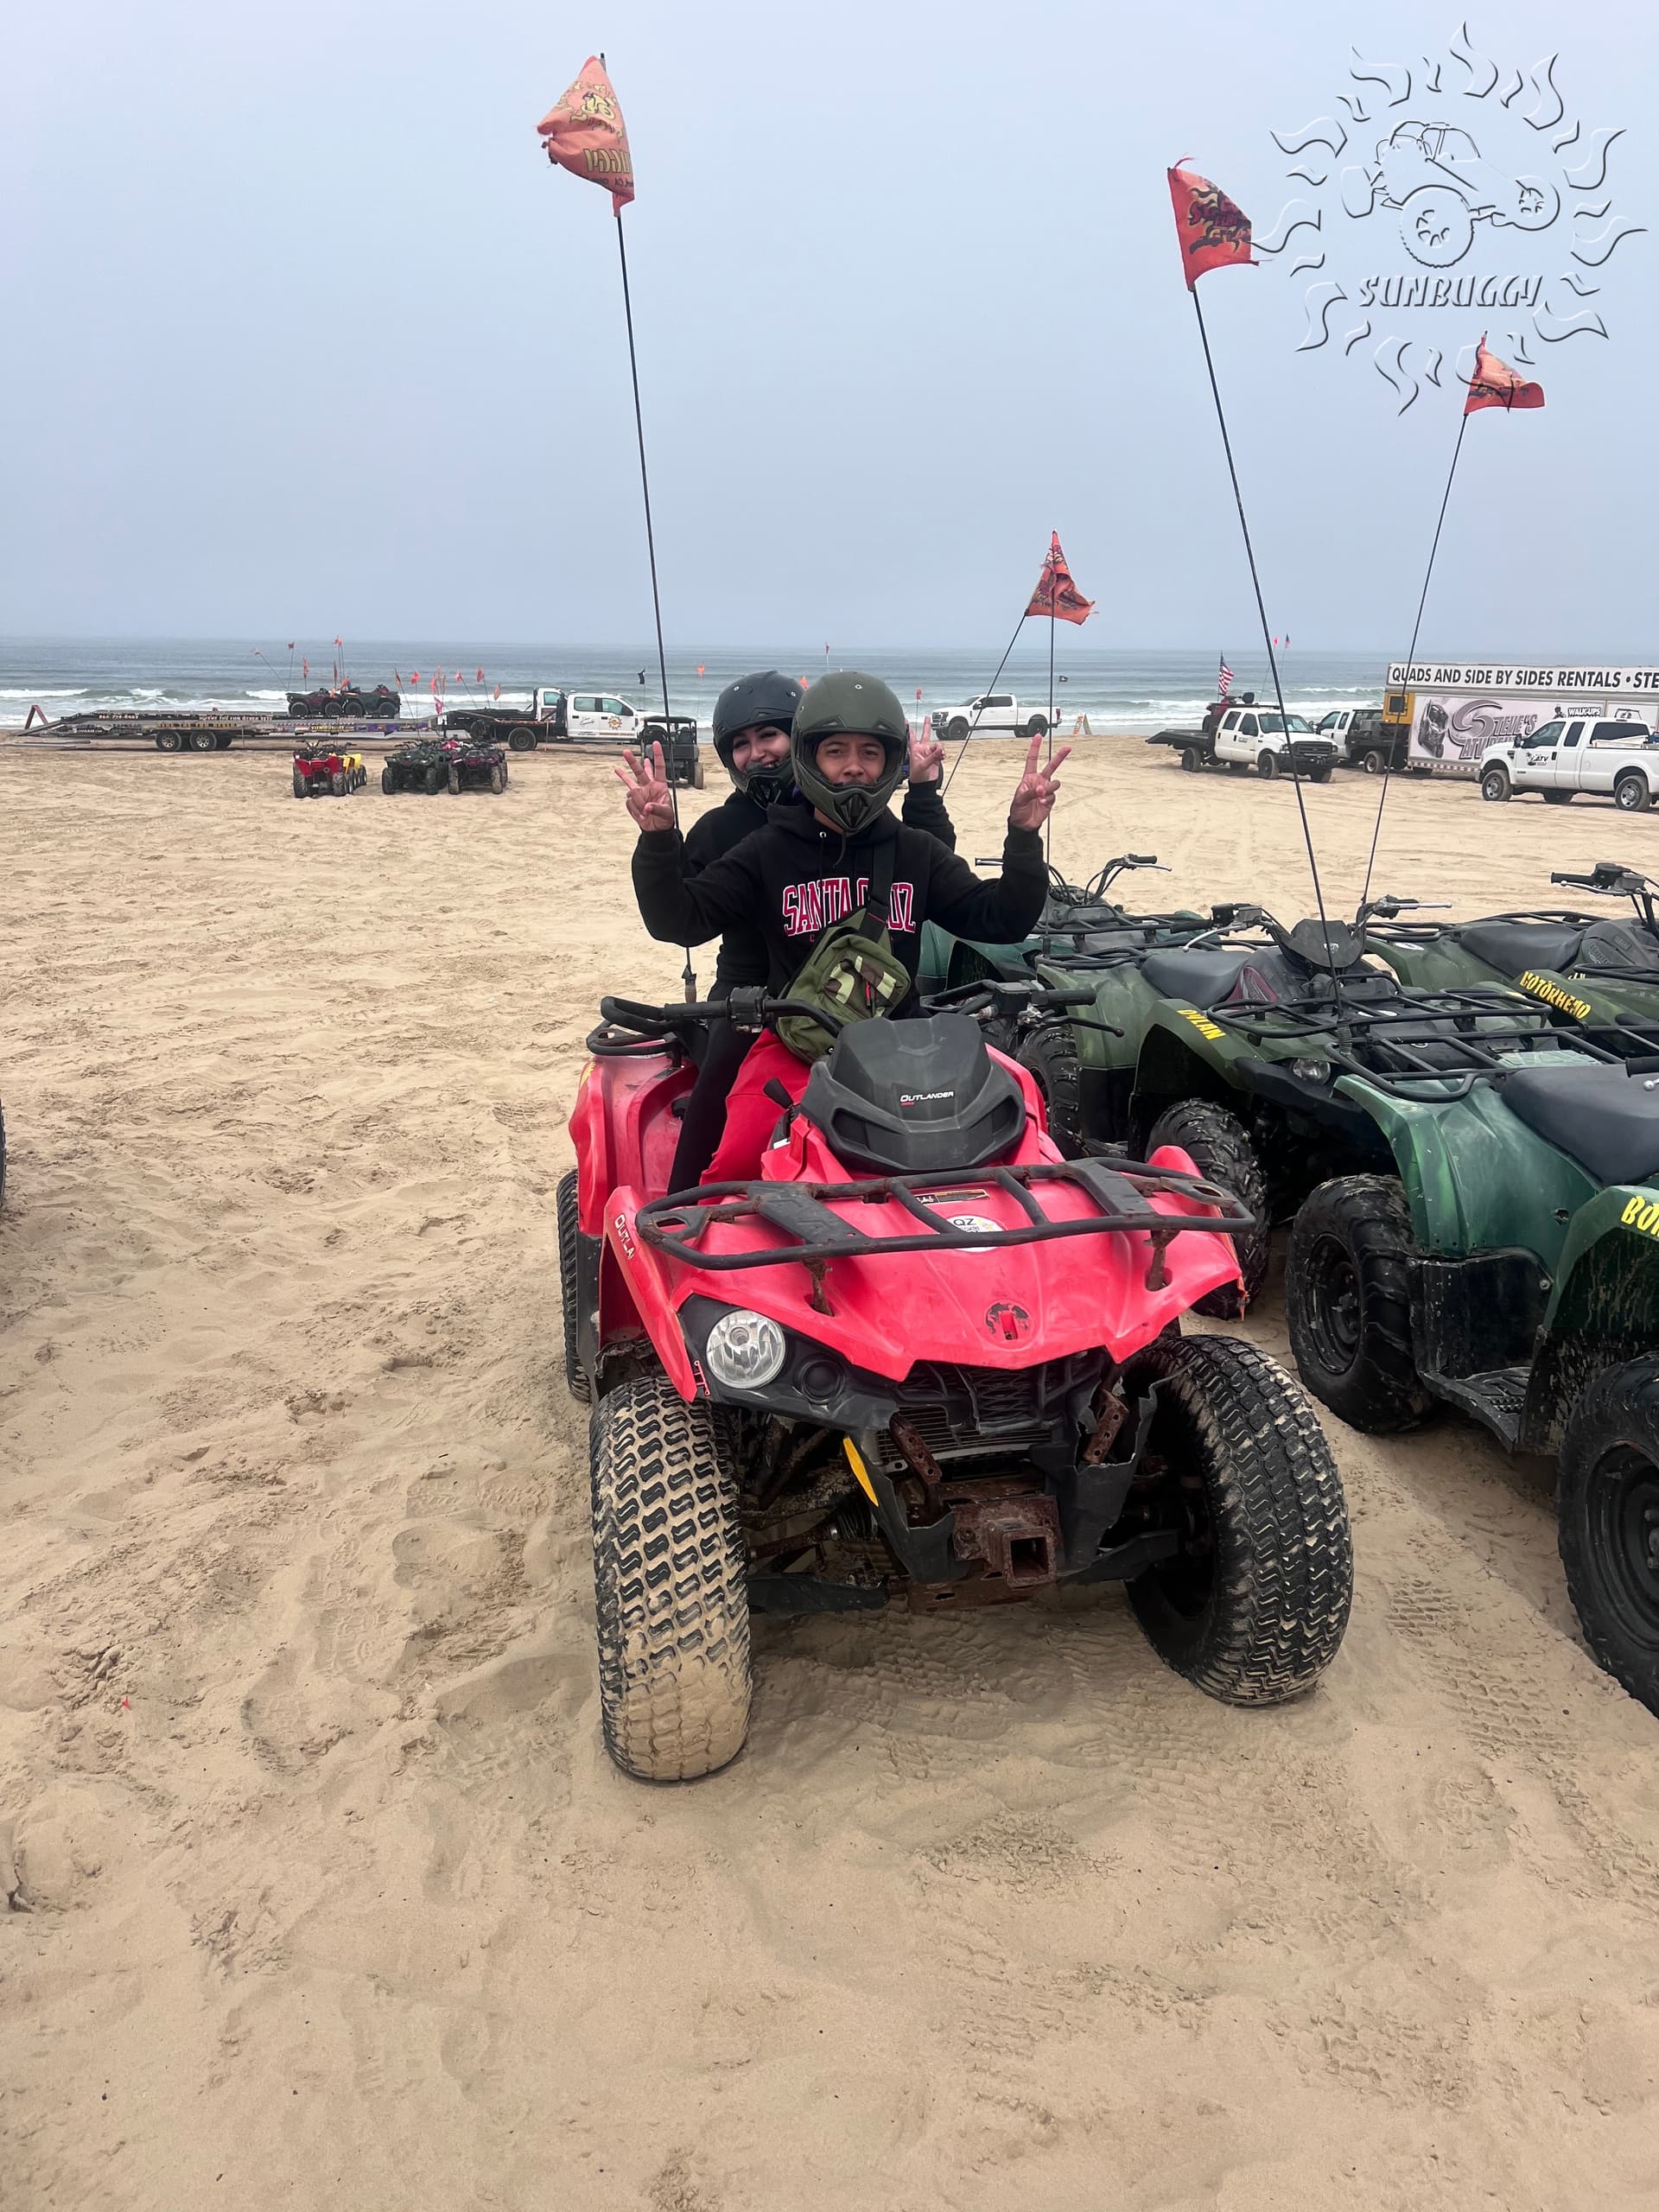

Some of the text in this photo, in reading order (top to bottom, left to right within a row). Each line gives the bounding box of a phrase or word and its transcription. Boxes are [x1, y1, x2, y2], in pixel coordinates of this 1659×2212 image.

[1392, 667, 1659, 689] QUADS AND SIDE BY SIDES RENTALS STE
[782, 877, 917, 937] SANTA CUZ
[1176, 1009, 1226, 1040] DYLAN
[899, 1090, 955, 1103] OUTLANDER
